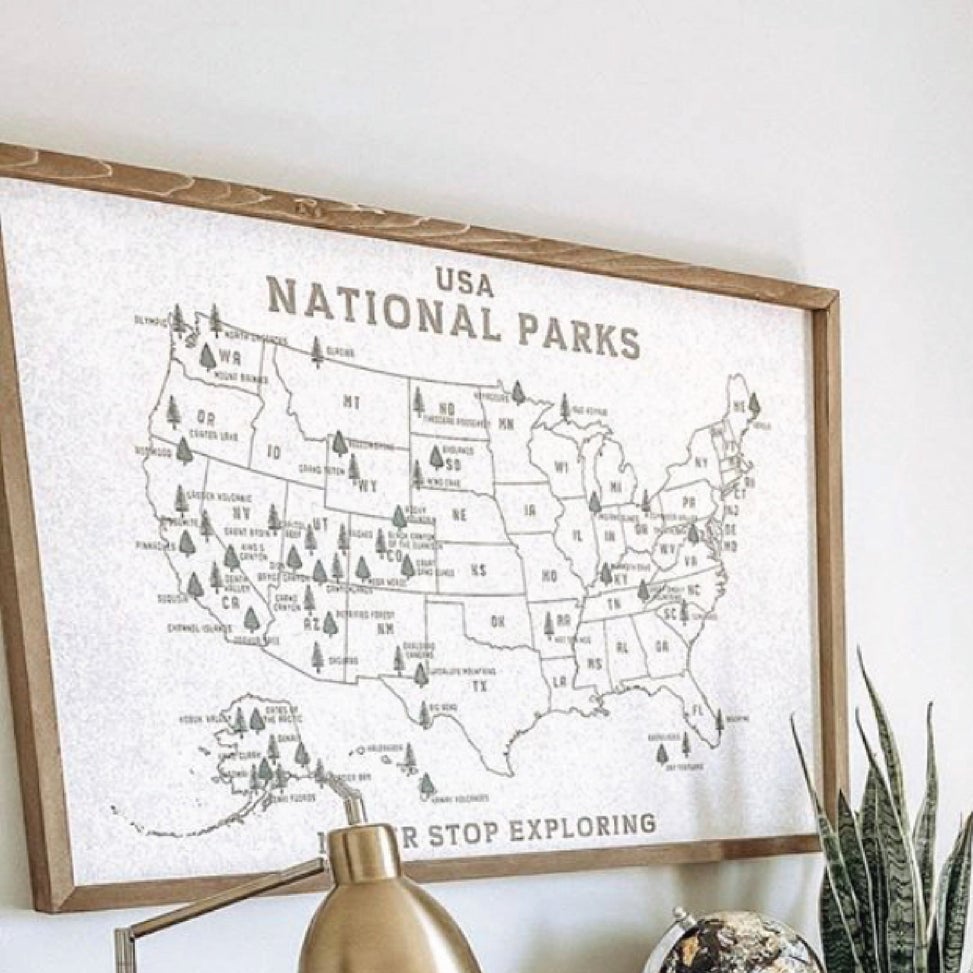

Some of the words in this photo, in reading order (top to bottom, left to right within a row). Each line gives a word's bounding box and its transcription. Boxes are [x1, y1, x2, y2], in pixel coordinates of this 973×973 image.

[436, 265, 494, 298] USA
[266, 275, 502, 342] NATIONAL
[517, 312, 641, 360] PARKS
[219, 348, 241, 366] WA
[343, 394, 360, 410] MT
[197, 409, 215, 427] OR
[498, 418, 514, 430] MN
[267, 444, 281, 460] ID
[446, 458, 461, 472] SD
[695, 456, 708, 468] NY
[358, 479, 377, 493] WY
[452, 507, 467, 522] NE
[313, 517, 328, 531] UT
[387, 549, 402, 562] CO
[685, 555, 698, 567] VA
[471, 563, 487, 576] KS
[222, 595, 240, 609] CA
[664, 608, 677, 620] SC
[304, 617, 321, 631] AZ
[377, 622, 394, 635] NM
[491, 615, 505, 628] OK
[473, 680, 487, 693] TX
[429, 822, 498, 847] STOP
[509, 813, 657, 842] EXPLORING
